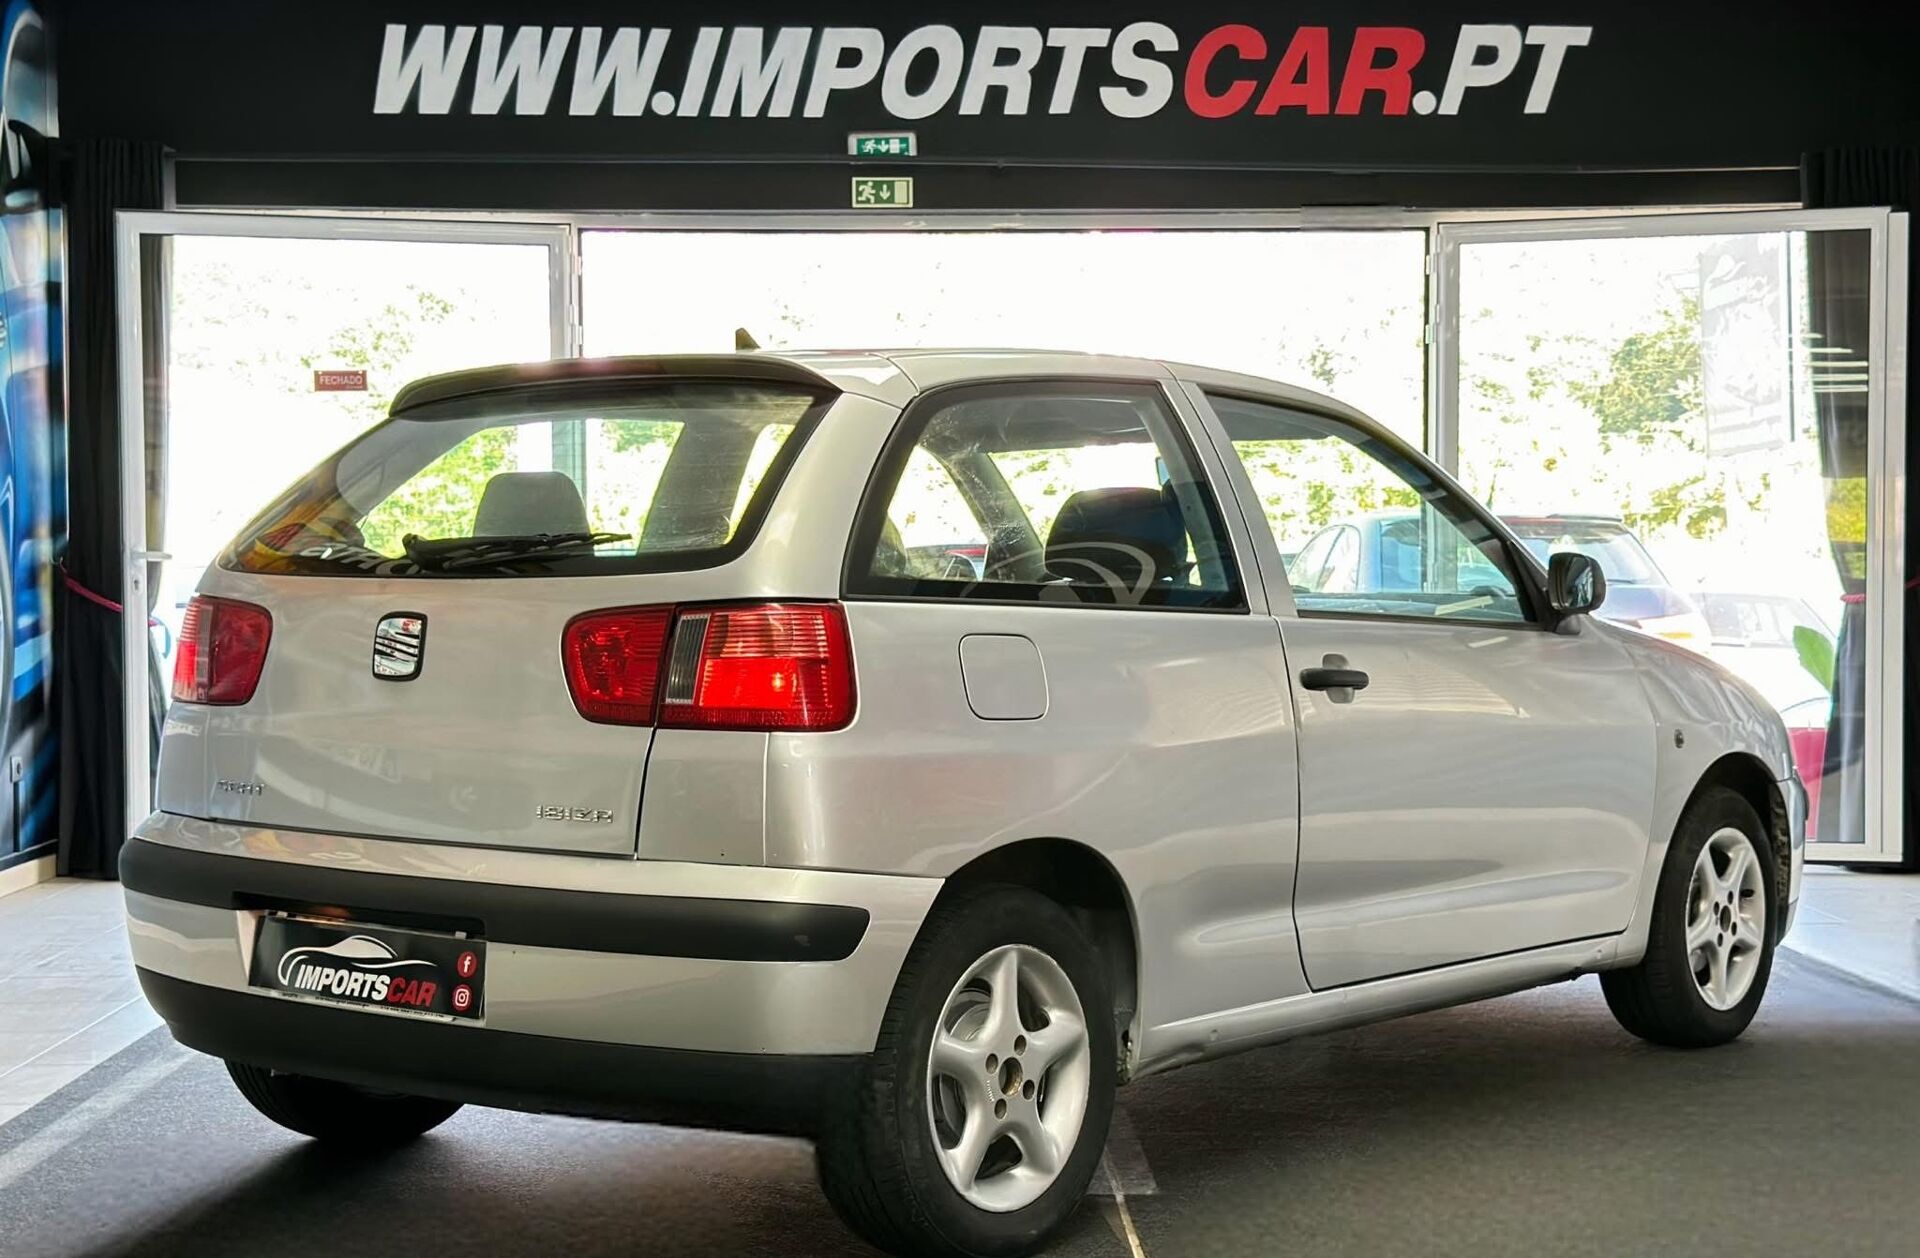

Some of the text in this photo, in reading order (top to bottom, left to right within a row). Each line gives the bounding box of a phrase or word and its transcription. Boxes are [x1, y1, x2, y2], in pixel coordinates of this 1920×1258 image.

[373, 21, 1593, 119] WWW.IMPORTSCAR.PT
[319, 375, 363, 385] FECHADO
[536, 805, 613, 823] IBIZA
[295, 964, 437, 1008] IMPORTSCAR
